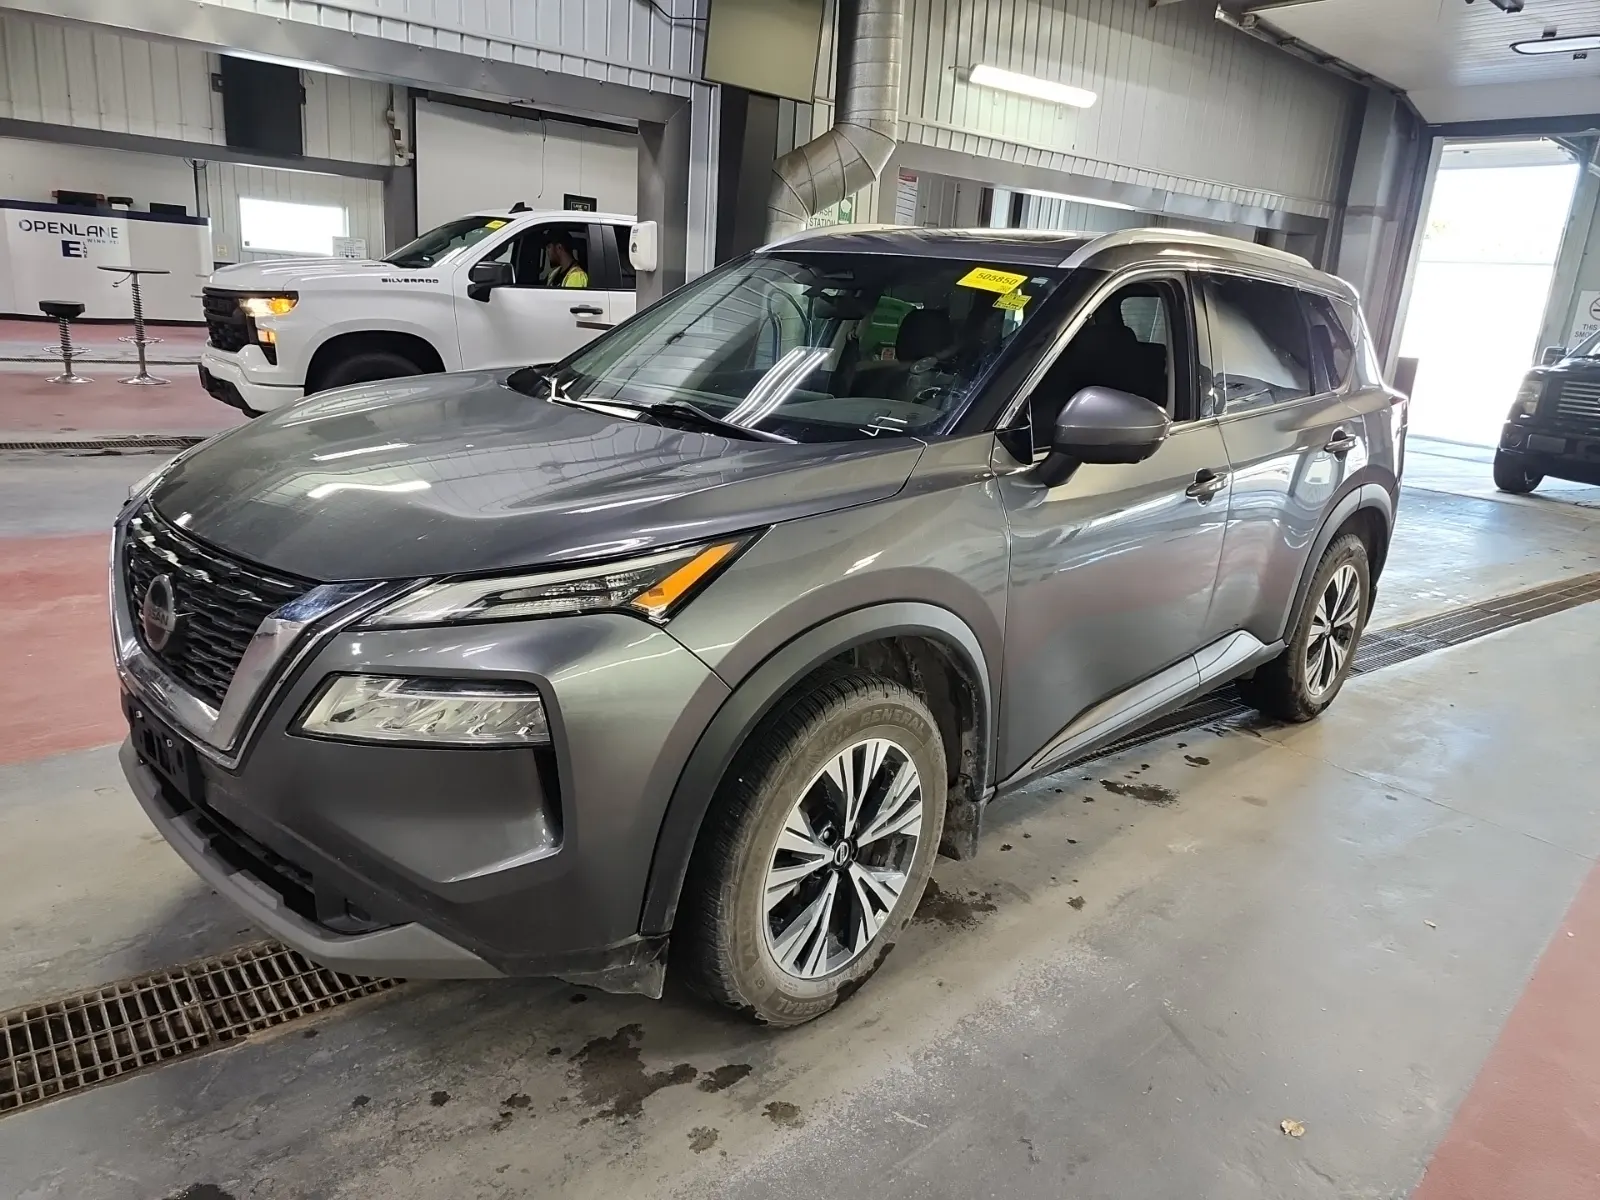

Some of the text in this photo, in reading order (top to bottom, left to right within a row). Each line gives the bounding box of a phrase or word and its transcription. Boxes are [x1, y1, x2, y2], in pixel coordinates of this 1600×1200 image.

[18, 219, 119, 239] OPENLANE
[61, 239, 83, 258] E
[976, 272, 1019, 286] 505850
[1582, 323, 1598, 331] THIS
[861, 708, 926, 737] GENERAL
